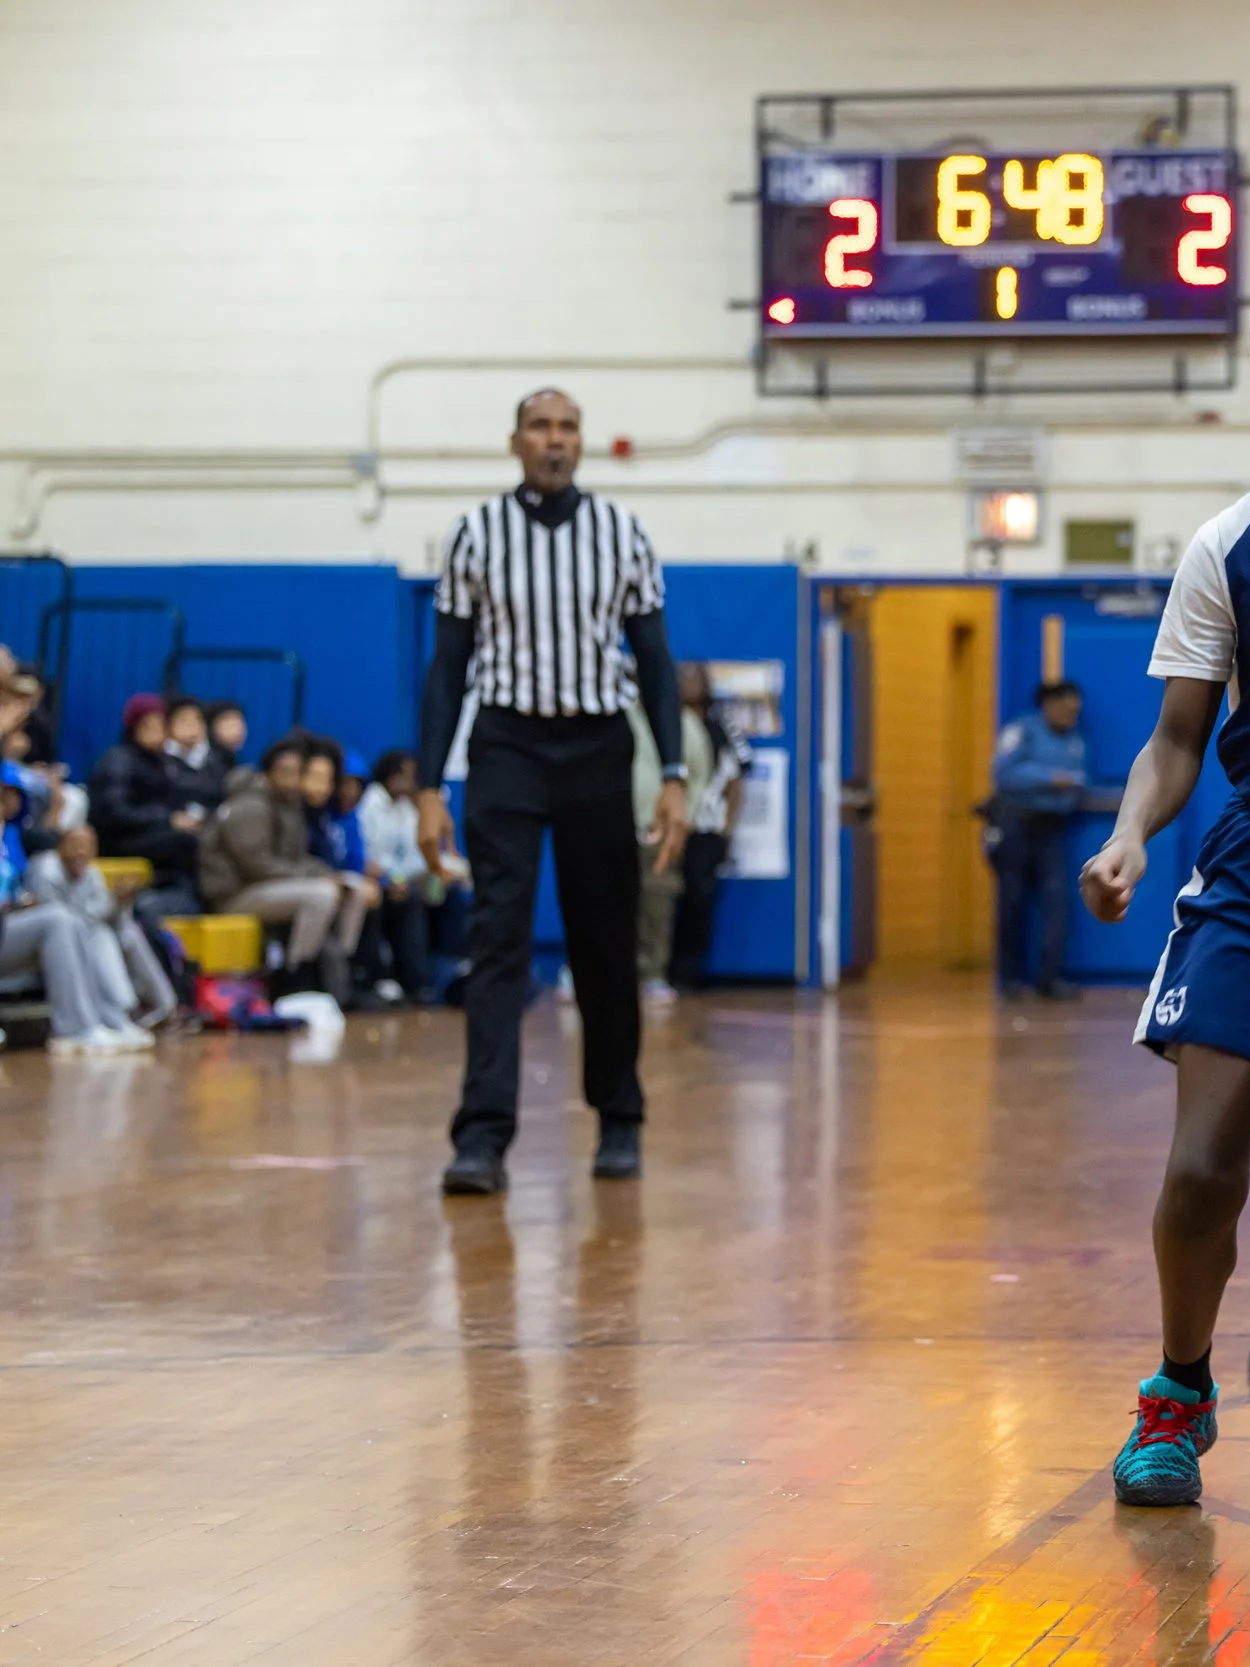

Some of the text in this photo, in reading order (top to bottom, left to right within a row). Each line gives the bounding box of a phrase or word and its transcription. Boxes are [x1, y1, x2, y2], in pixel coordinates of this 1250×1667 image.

[824, 199, 877, 288] 2
[1177, 193, 1232, 285] 2
[996, 266, 1017, 319] 1
